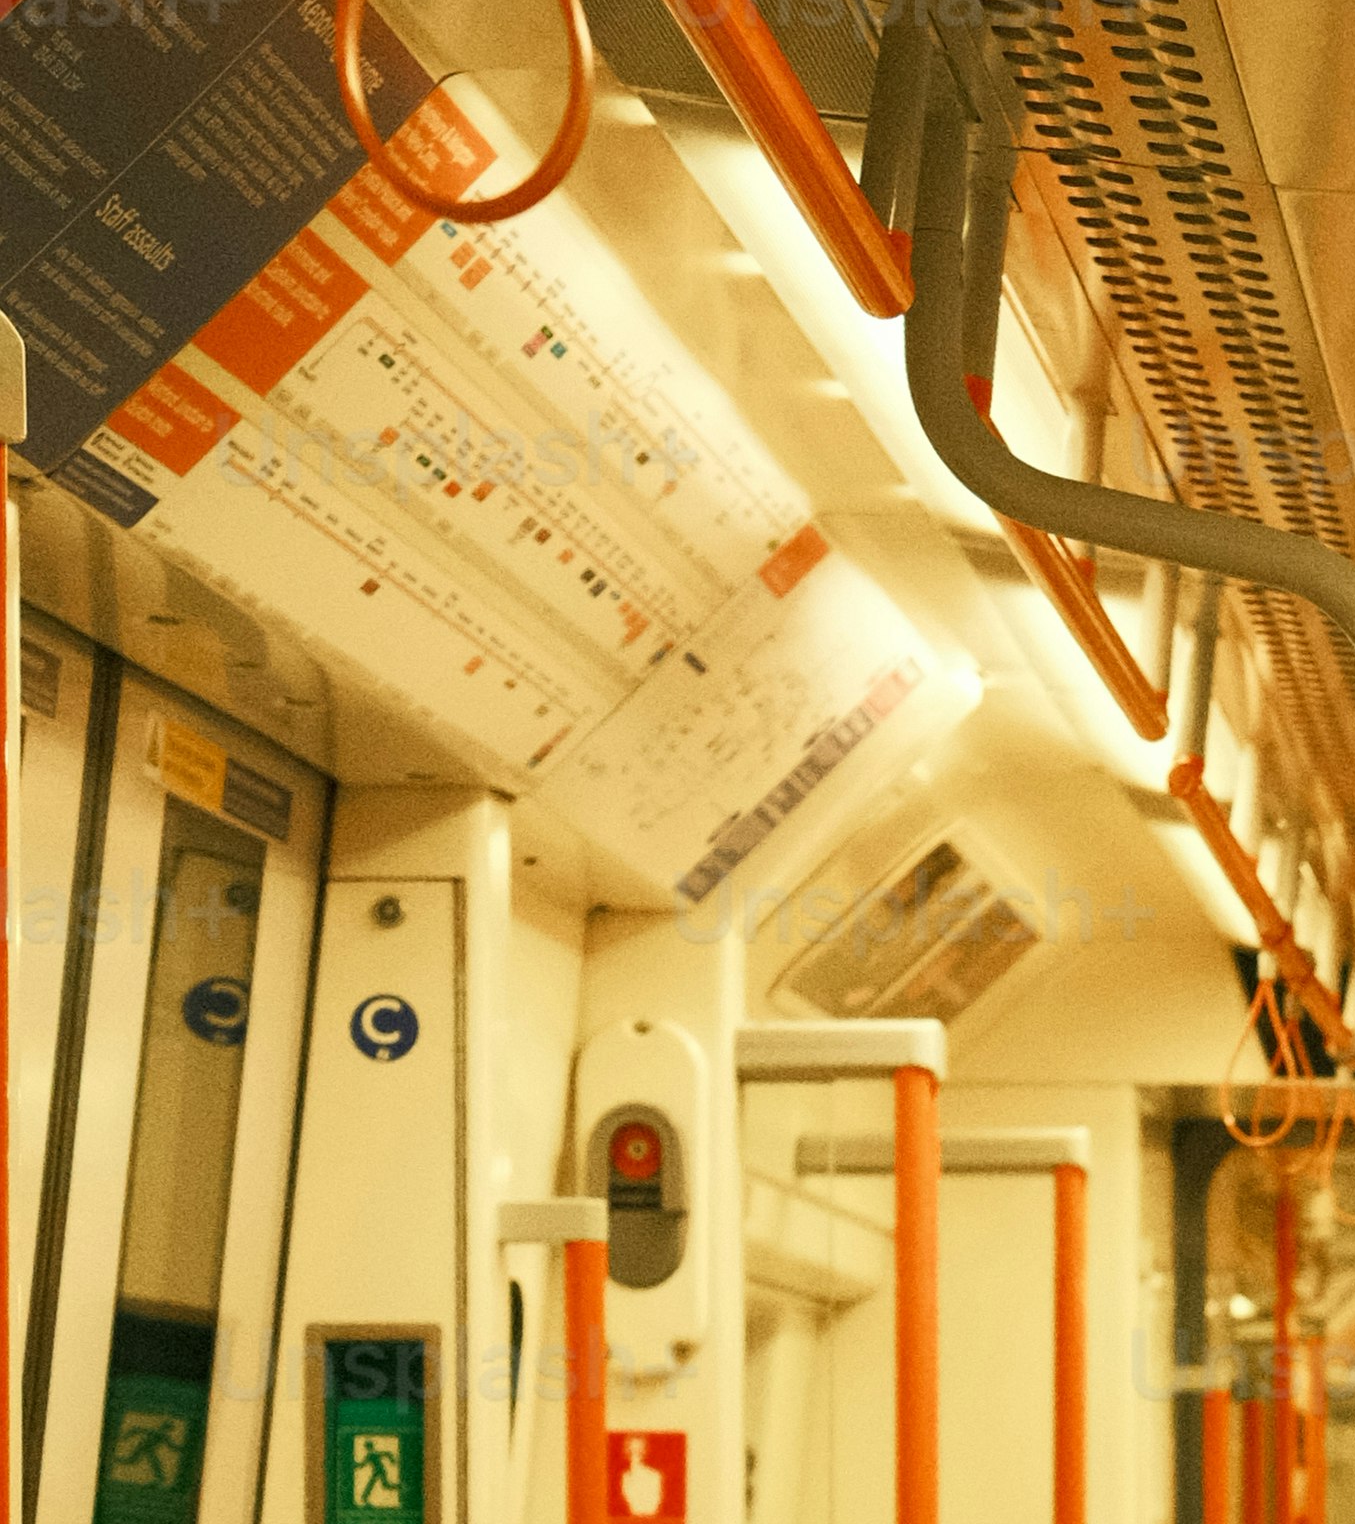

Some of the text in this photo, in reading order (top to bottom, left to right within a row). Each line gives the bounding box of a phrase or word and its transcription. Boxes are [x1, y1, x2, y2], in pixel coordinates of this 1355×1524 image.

[95, 192, 176, 272] Staff assaults
[361, 998, 400, 1044] C
